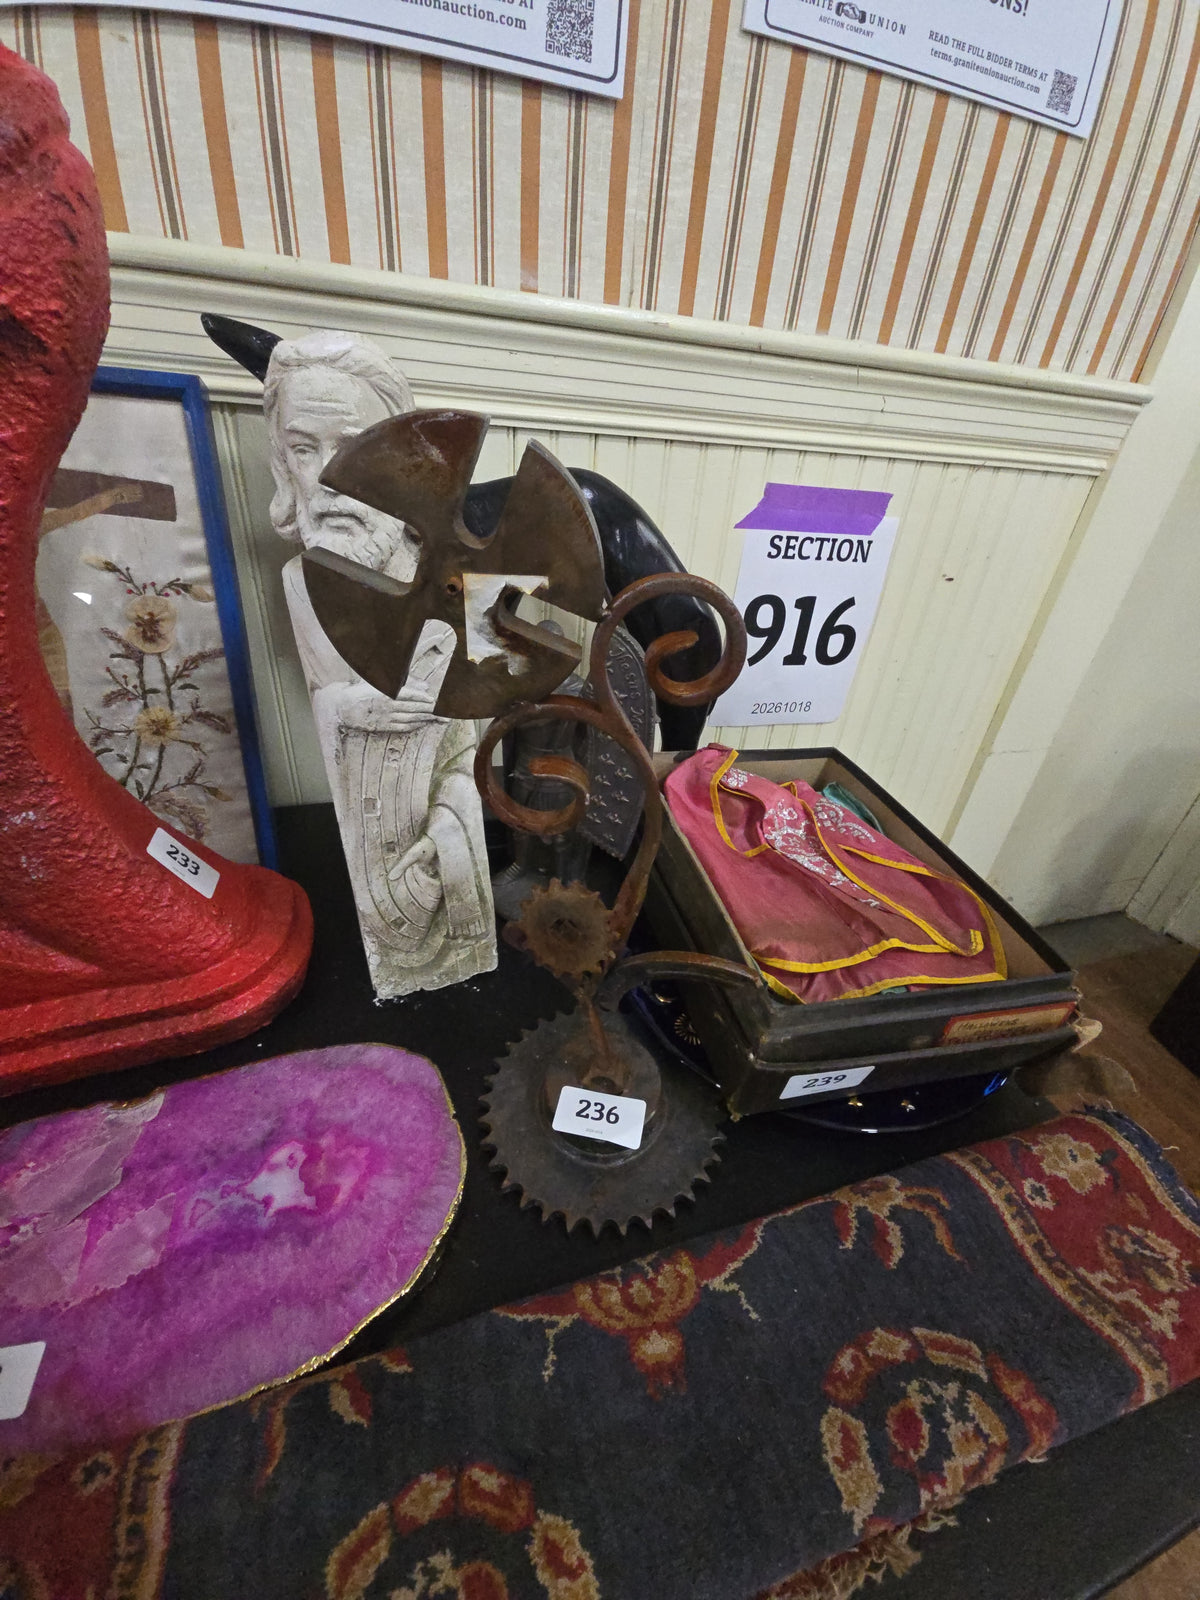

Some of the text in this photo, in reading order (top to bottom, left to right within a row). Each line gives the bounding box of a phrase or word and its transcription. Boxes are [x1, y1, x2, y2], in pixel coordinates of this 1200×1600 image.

[818, 14, 874, 39] AUCTION COMPANY
[869, 13, 907, 36] UNION
[928, 30, 1049, 82] READ THE FULL BIDDER TERMS AT
[930, 48, 1041, 94] terms.graniteunionauction.com
[767, 534, 873, 563] SECTION
[743, 594, 857, 667] 916
[751, 701, 812, 715] 20261018
[166, 844, 200, 876] 233
[802, 1074, 847, 1089] 239
[575, 1099, 620, 1124] 236
